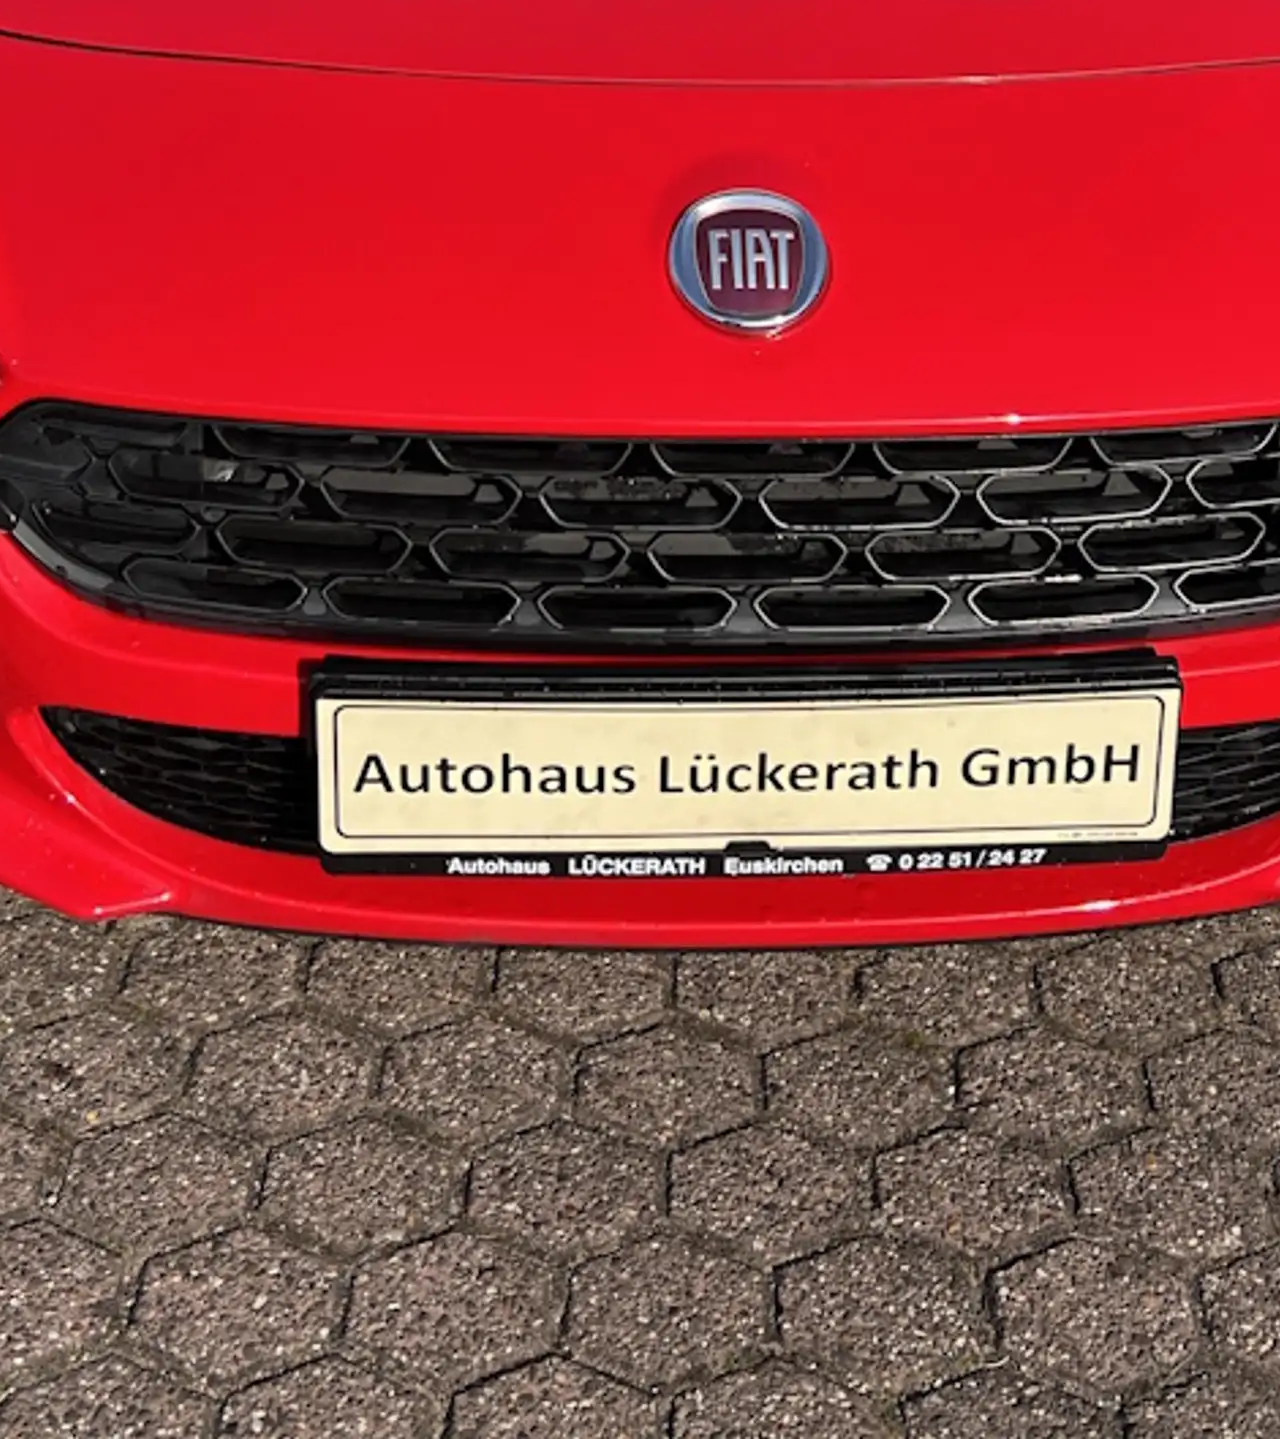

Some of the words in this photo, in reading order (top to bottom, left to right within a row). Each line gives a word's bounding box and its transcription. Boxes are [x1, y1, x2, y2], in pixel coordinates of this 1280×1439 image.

[707, 228, 795, 290] FIAT
[352, 752, 636, 794] Autohaus
[658, 748, 939, 794] Lückerath
[960, 743, 1141, 787] GmbH
[447, 857, 551, 876] Autohaus
[568, 854, 707, 876] LÜCKERATH
[723, 856, 844, 875] Euskirchen
[898, 853, 913, 871] 0
[916, 852, 944, 870] 22
[1019, 848, 1048, 865] 27
